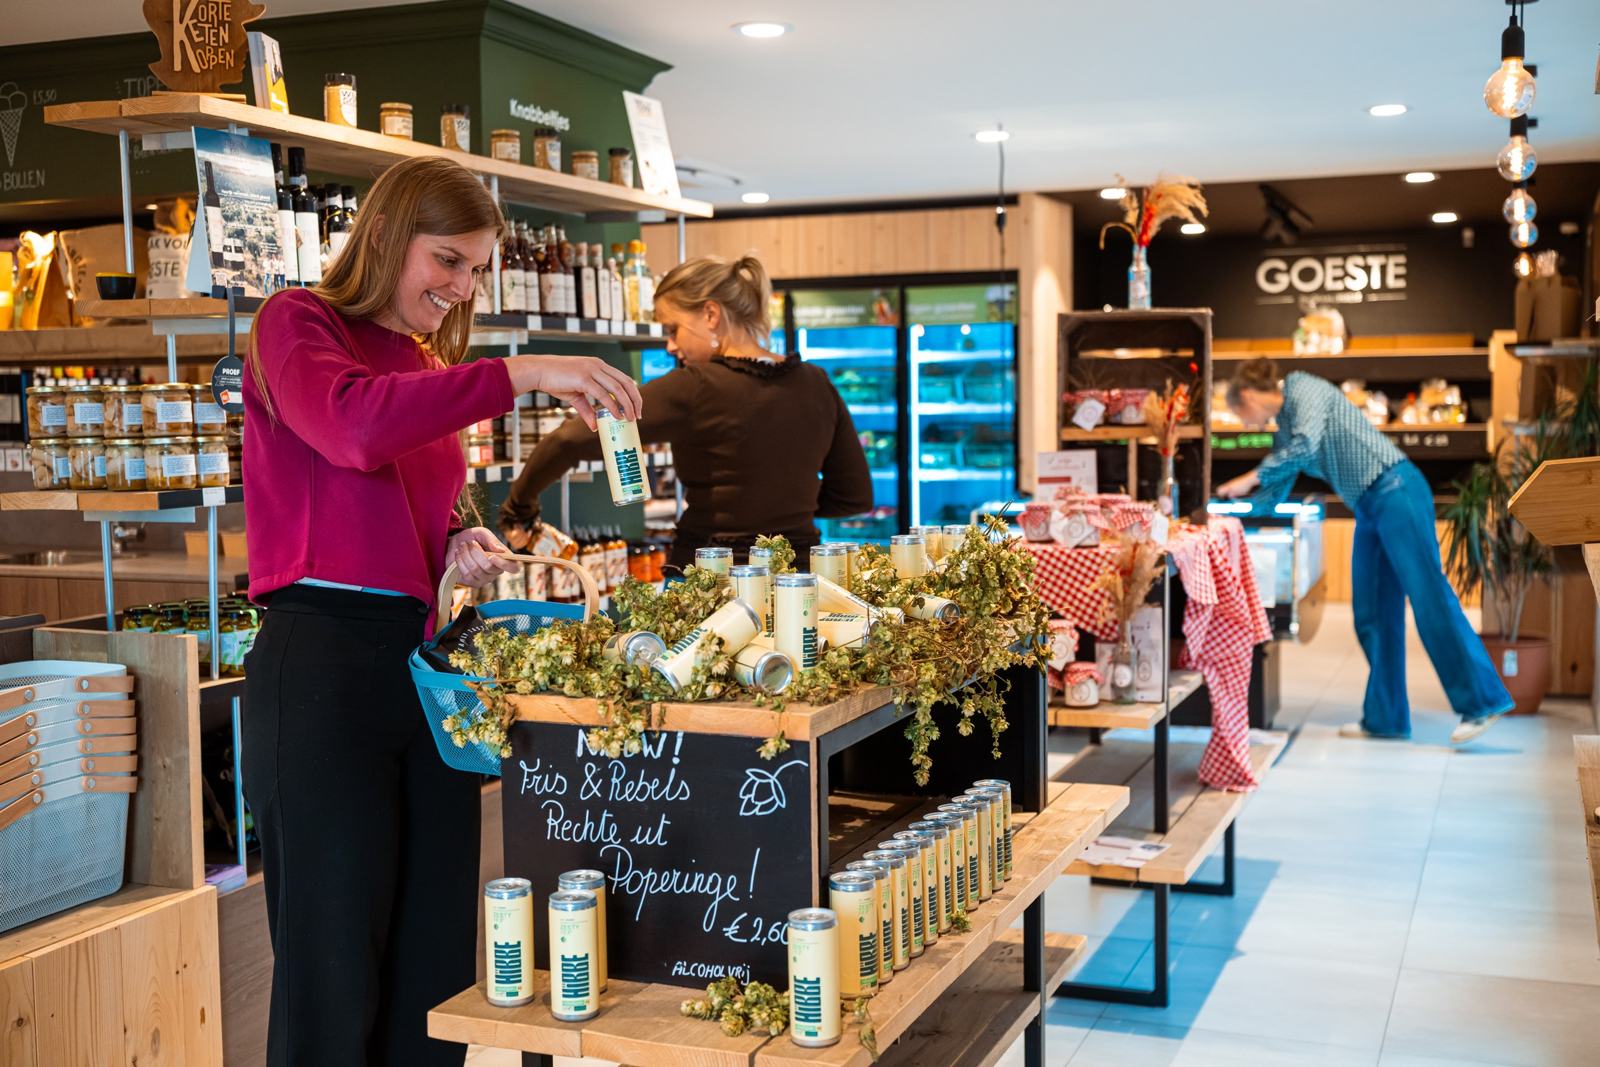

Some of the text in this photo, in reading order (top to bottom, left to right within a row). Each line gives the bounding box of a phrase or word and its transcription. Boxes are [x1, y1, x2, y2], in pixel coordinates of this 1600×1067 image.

[1256, 254, 1408, 294] GOESTE
[576, 726, 684, 765] NUW!
[519, 757, 690, 802] Fris & Rebels
[541, 800, 672, 846] Rechte ut
